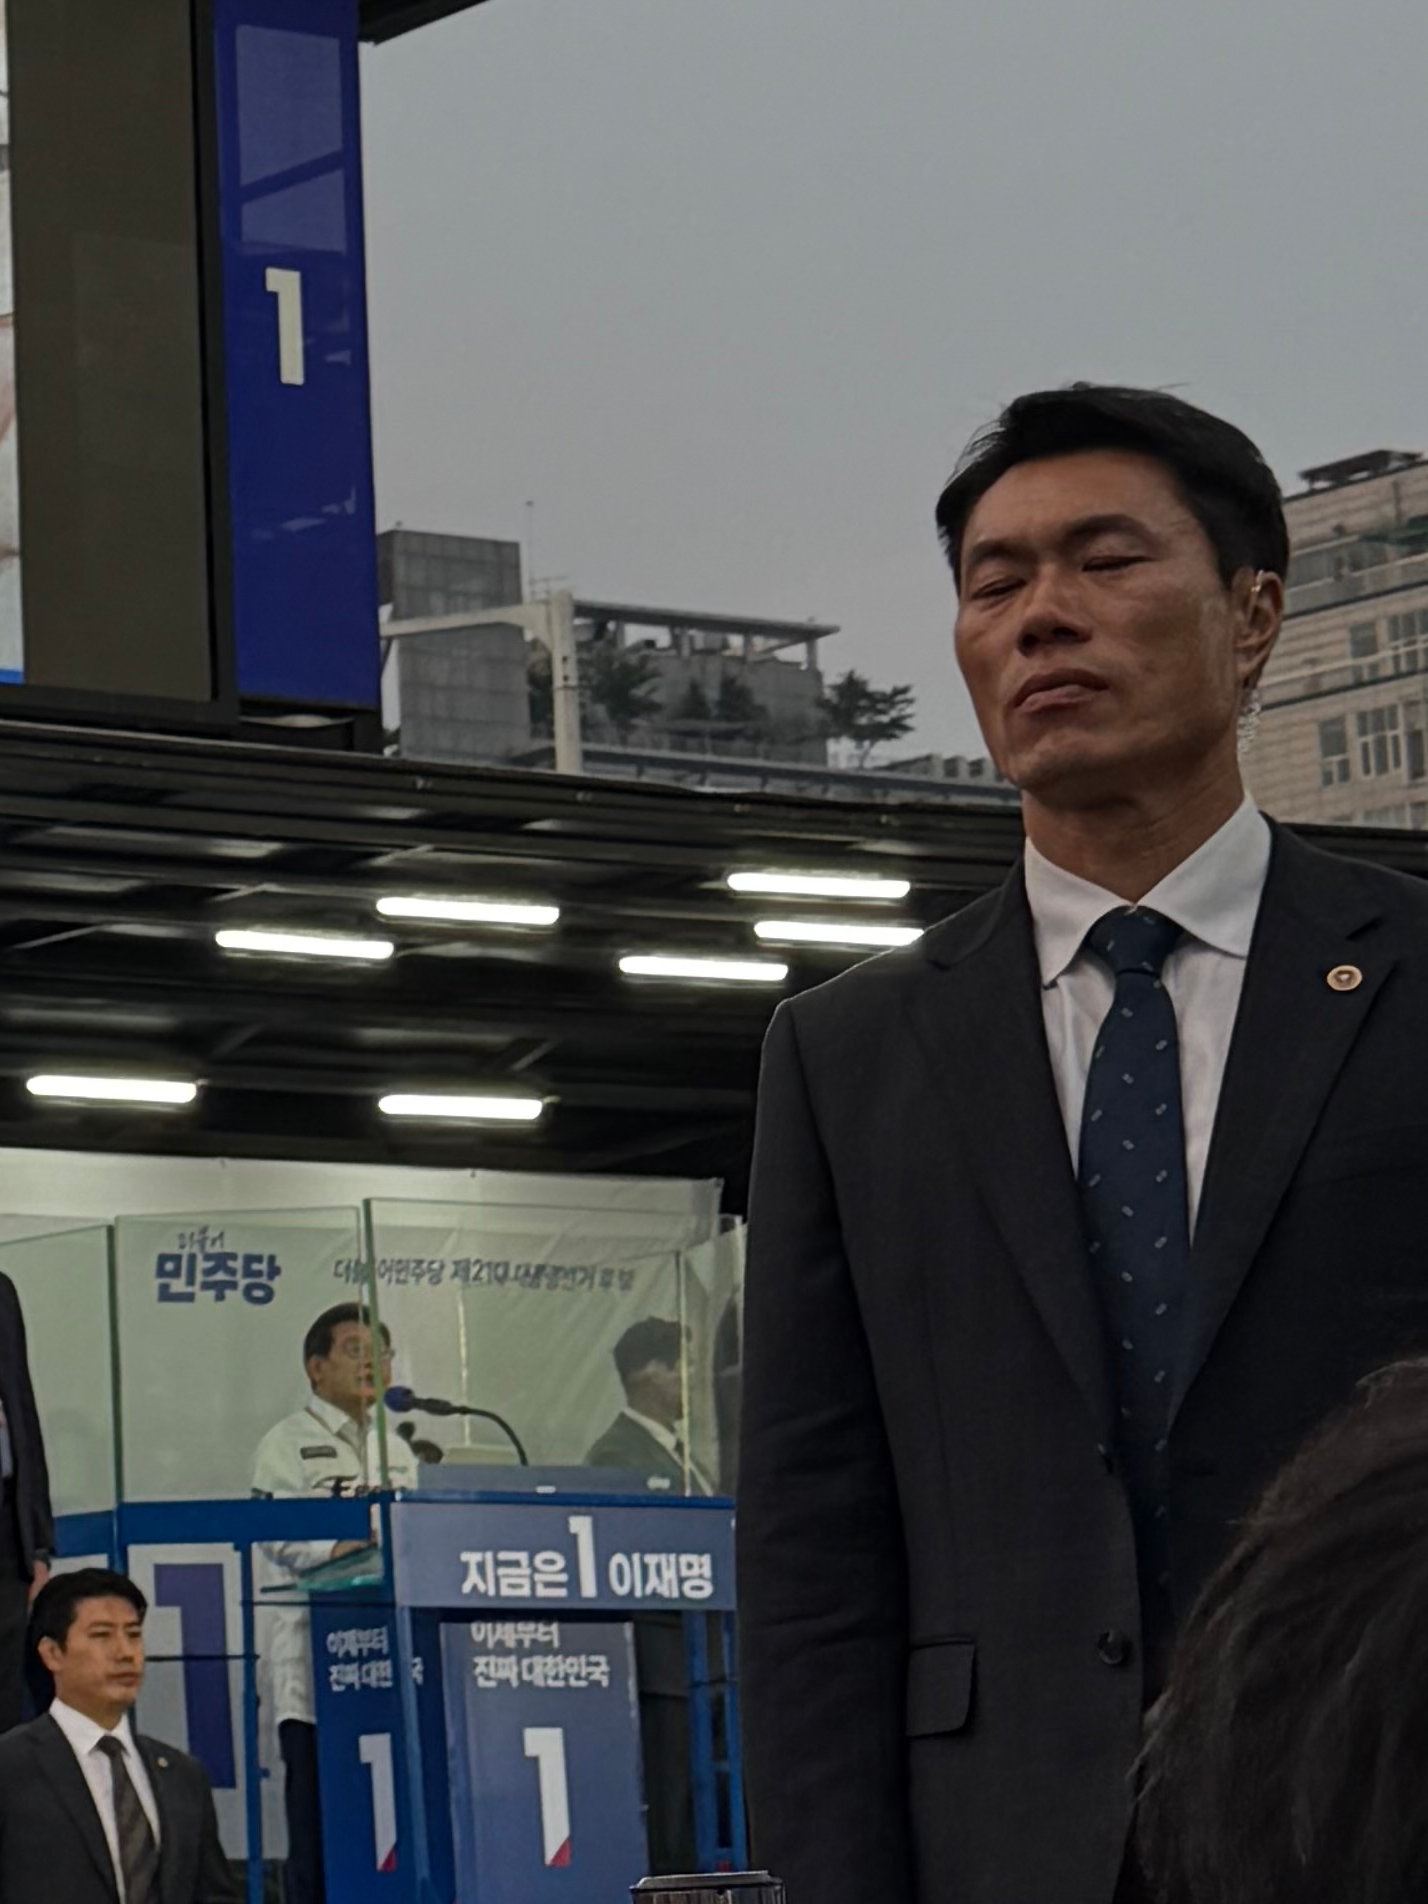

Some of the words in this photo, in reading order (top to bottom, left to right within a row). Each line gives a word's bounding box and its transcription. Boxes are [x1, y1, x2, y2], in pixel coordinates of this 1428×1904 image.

[265, 267, 305, 386] 1
[155, 1252, 281, 1305] 민주당
[459, 1550, 568, 1598] 지금은
[568, 1515, 597, 1598] 1
[608, 1551, 714, 1599] 이재명
[472, 1655, 519, 1689] 진짜
[521, 1654, 611, 1688] 대한민국
[358, 1732, 398, 1872] 1
[523, 1727, 572, 1868] 1
